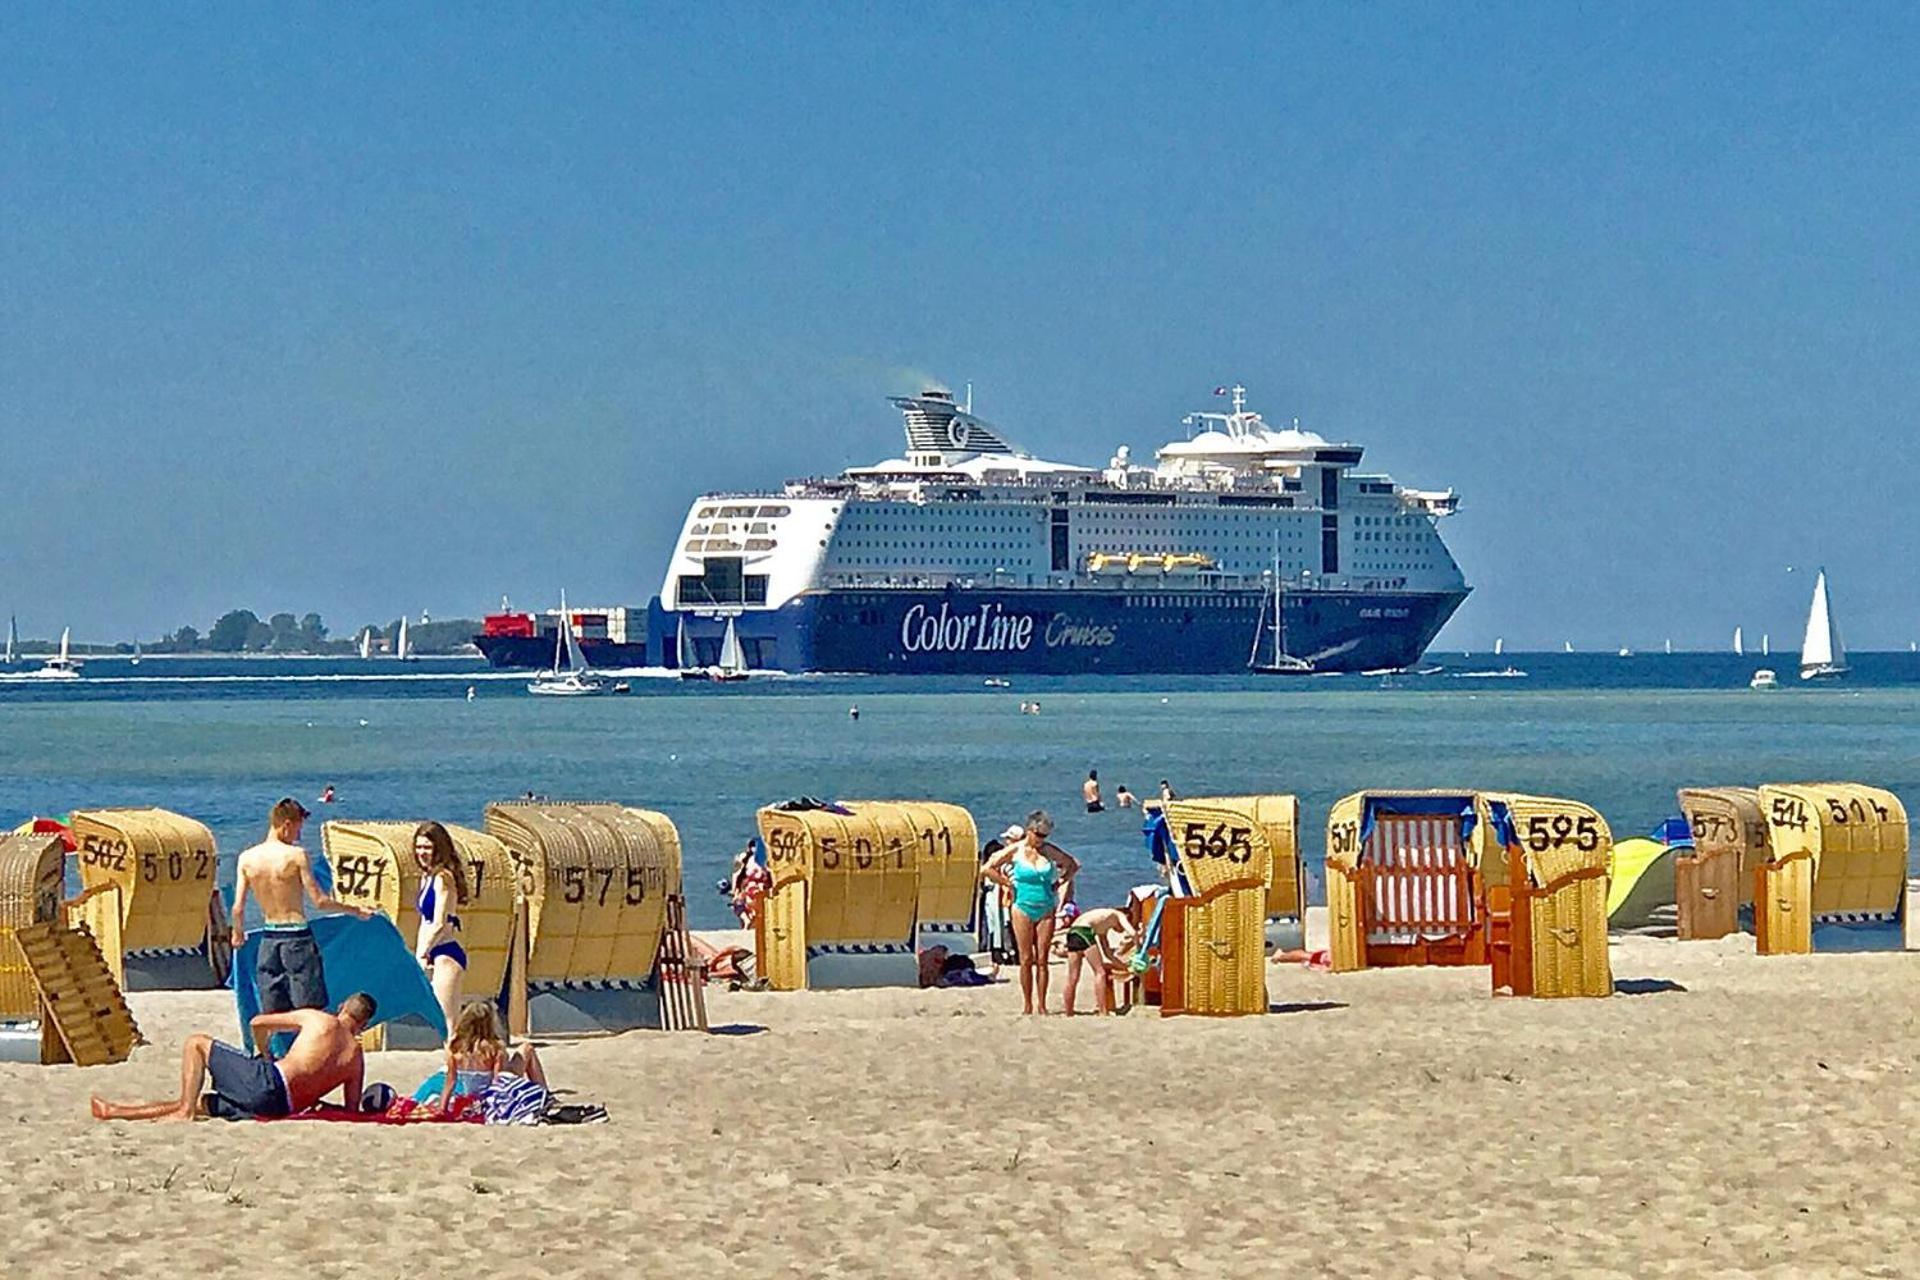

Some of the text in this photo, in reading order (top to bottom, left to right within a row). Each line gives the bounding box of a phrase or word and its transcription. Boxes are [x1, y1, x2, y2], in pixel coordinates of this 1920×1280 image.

[1692, 813, 1738, 842] 573
[1772, 798, 1809, 832] 514
[1827, 798, 1888, 823] 514
[921, 826, 952, 856] 11
[1185, 822, 1252, 864] 565
[1529, 814, 1598, 852] 595
[83, 835, 129, 872] 502
[143, 849, 209, 883] 502
[820, 837, 903, 870] 501
[564, 865, 645, 907] 575
